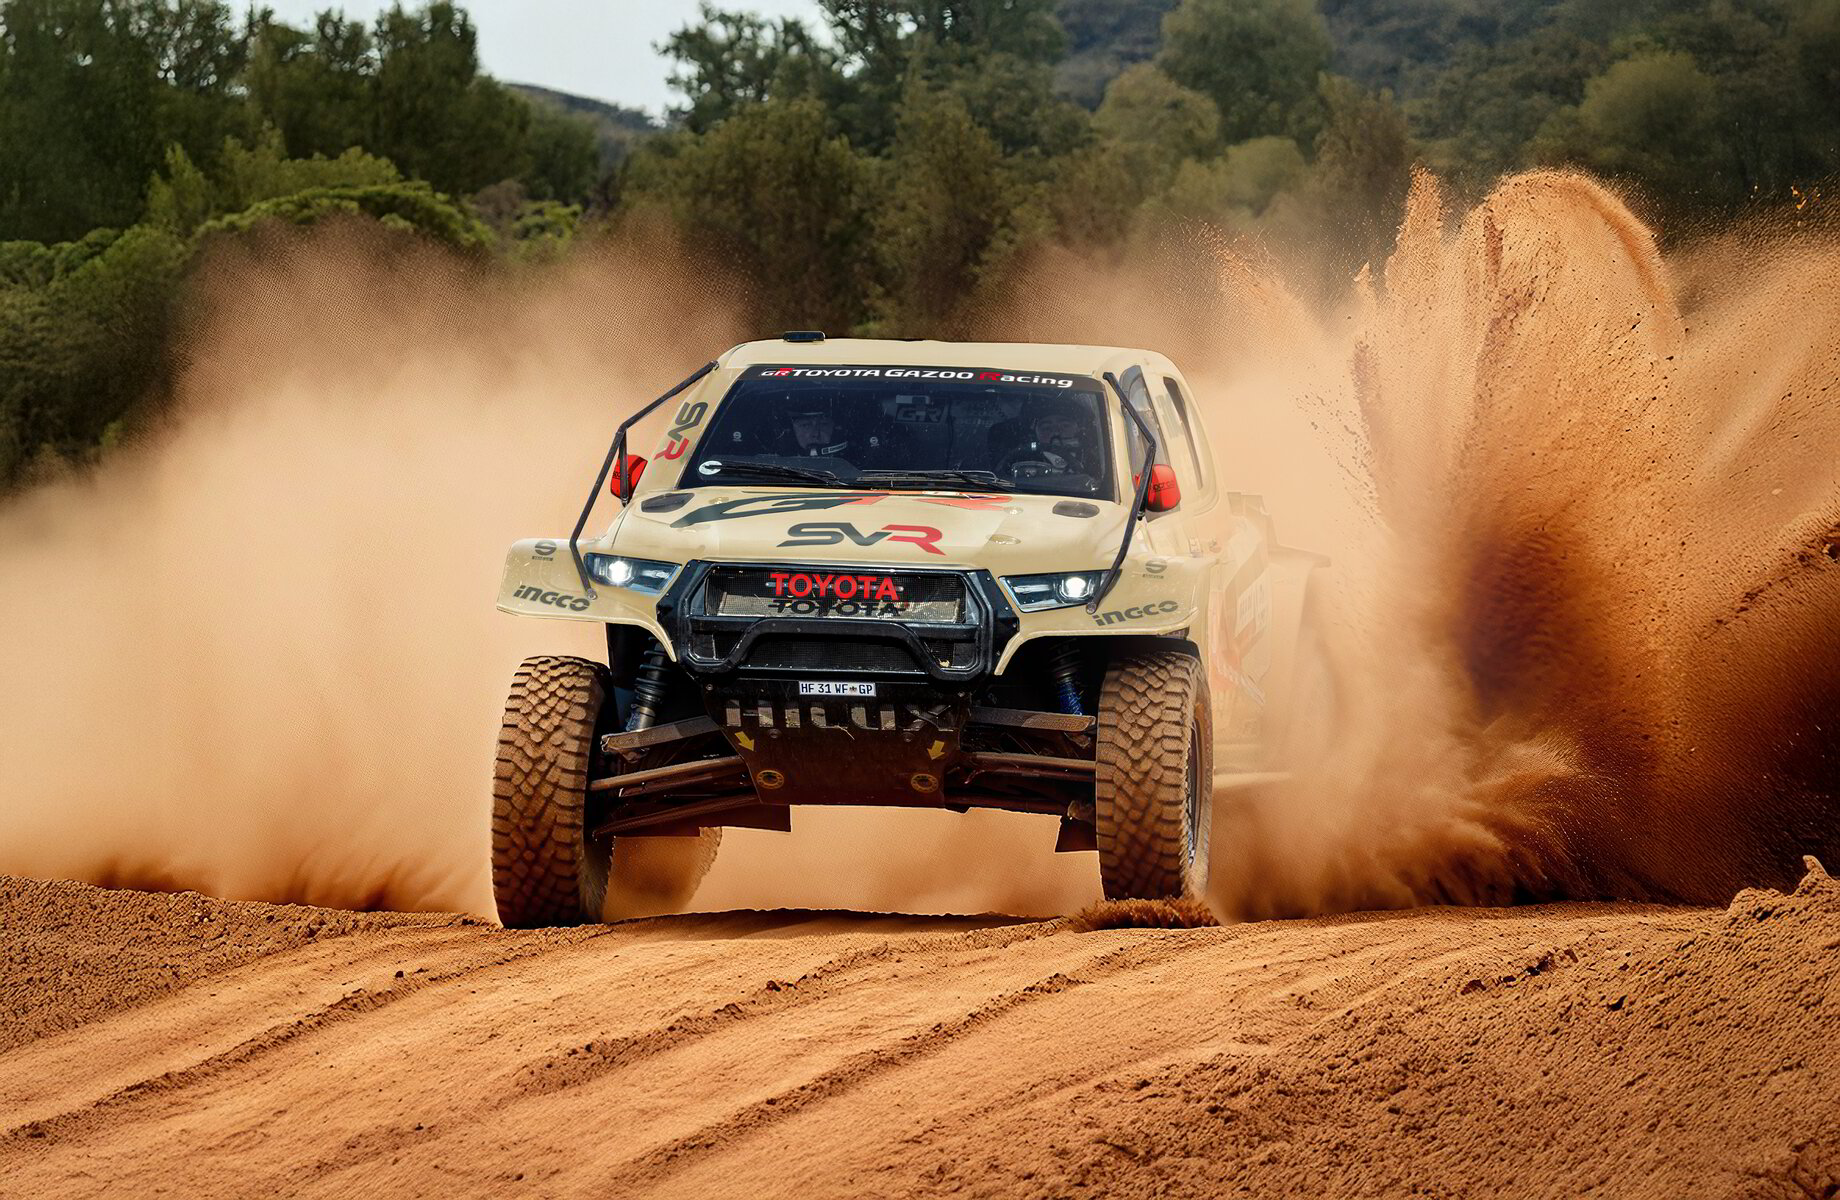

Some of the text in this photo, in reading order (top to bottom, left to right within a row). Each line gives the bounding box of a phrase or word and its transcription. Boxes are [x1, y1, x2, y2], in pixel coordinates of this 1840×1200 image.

[791, 368, 881, 378] TOYOTA
[884, 368, 975, 380] GAZOO
[979, 371, 1074, 388] Racing
[653, 401, 709, 461] SVR
[775, 521, 947, 556] SVR
[769, 573, 900, 601] TOYOTA
[800, 683, 815, 693] HF
[817, 683, 832, 694] 31
[858, 684, 873, 695] GP
